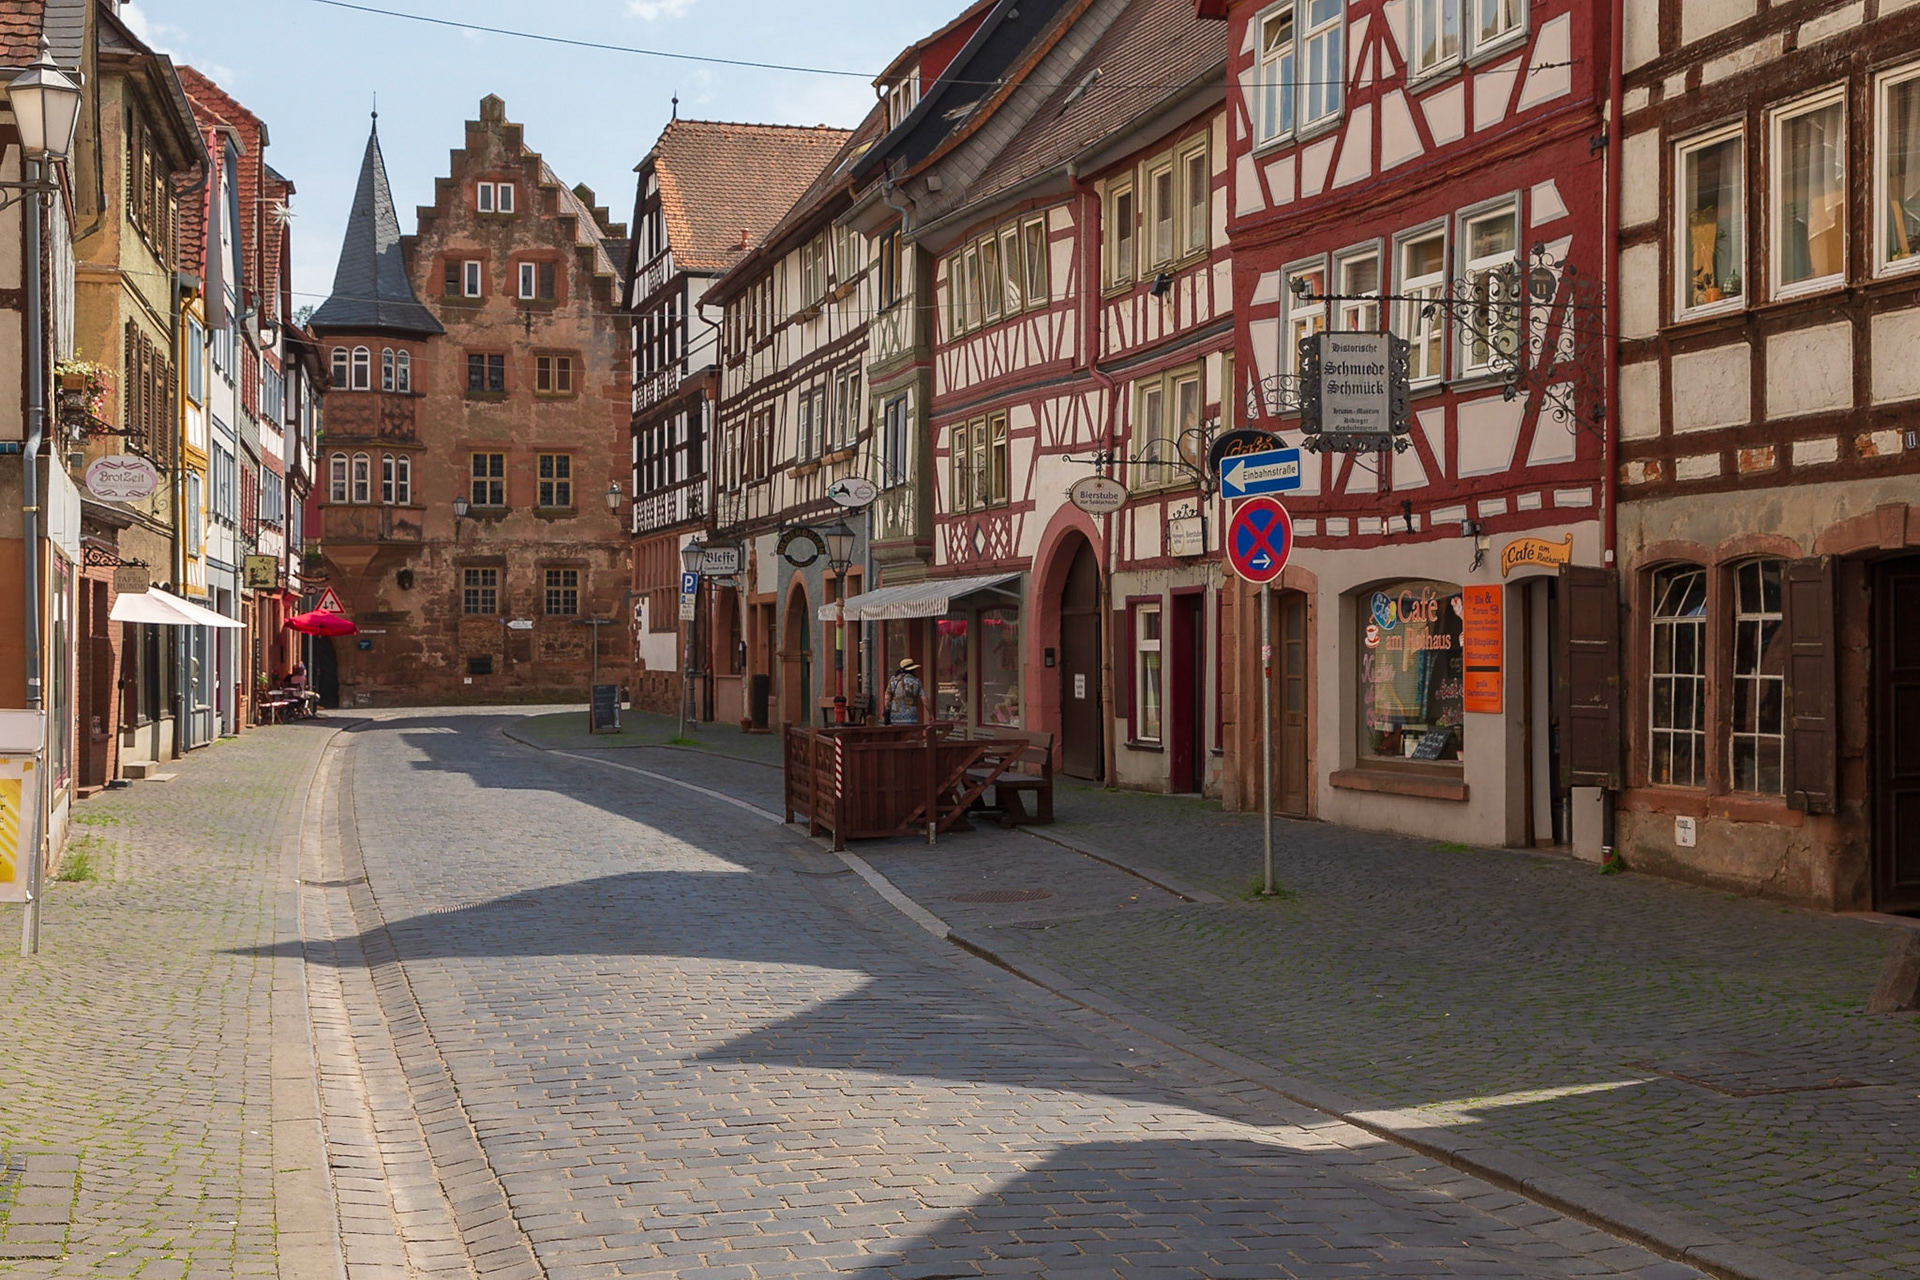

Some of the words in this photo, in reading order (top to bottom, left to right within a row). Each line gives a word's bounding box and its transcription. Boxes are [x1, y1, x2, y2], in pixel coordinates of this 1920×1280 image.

[1536, 283, 1546, 295] 11
[1332, 342, 1377, 354] Historische
[1324, 361, 1385, 376] Schmiede
[1327, 380, 1384, 396] Schmück
[99, 471, 144, 483] BrotZeit
[1243, 464, 1296, 481] Einbahnstraße
[1080, 491, 1118, 499] Bierstube
[1507, 541, 1535, 564] Café
[1538, 545, 1550, 553] am
[684, 575, 694, 593] P
[1398, 586, 1438, 623] Café
[1485, 591, 1491, 604] &
[1386, 635, 1402, 651] am
[1406, 626, 1452, 650] Rathaus
